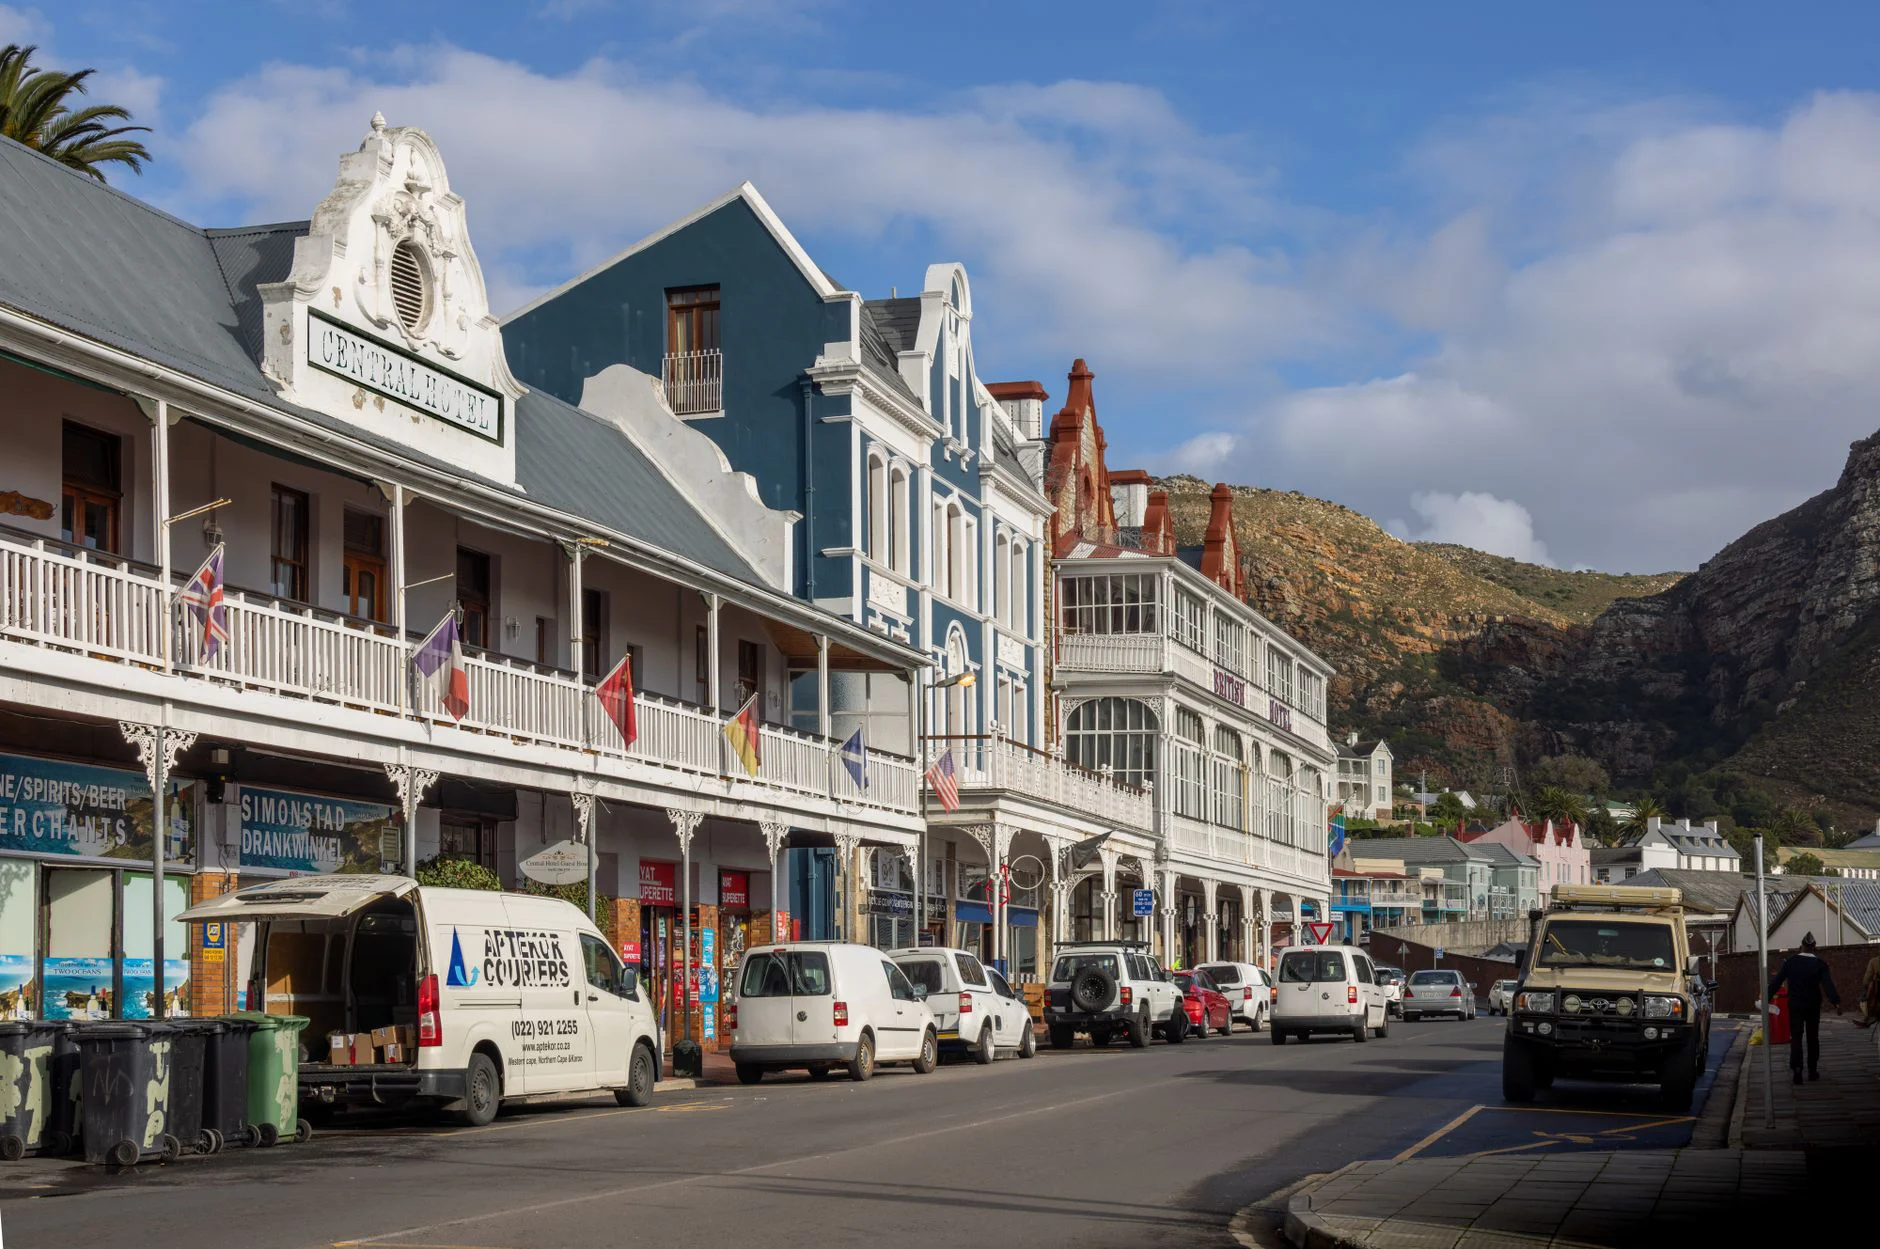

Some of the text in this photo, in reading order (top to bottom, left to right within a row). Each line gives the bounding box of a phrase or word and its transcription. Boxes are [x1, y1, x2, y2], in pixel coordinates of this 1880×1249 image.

[322, 330, 489, 430] CENTRAL HOTEL
[1213, 668, 1292, 732] BRITISH HOTEL
[241, 794, 345, 832] SIMONSTAD
[242, 829, 345, 863] DRANKWINKEL
[640, 885, 673, 901] UPERETTE
[484, 930, 564, 960] APTEKOR
[483, 958, 570, 988] COURIERS
[511, 1020, 578, 1040] (022) 921 2255
[522, 1041, 571, 1053] www.aptekor.co.za
